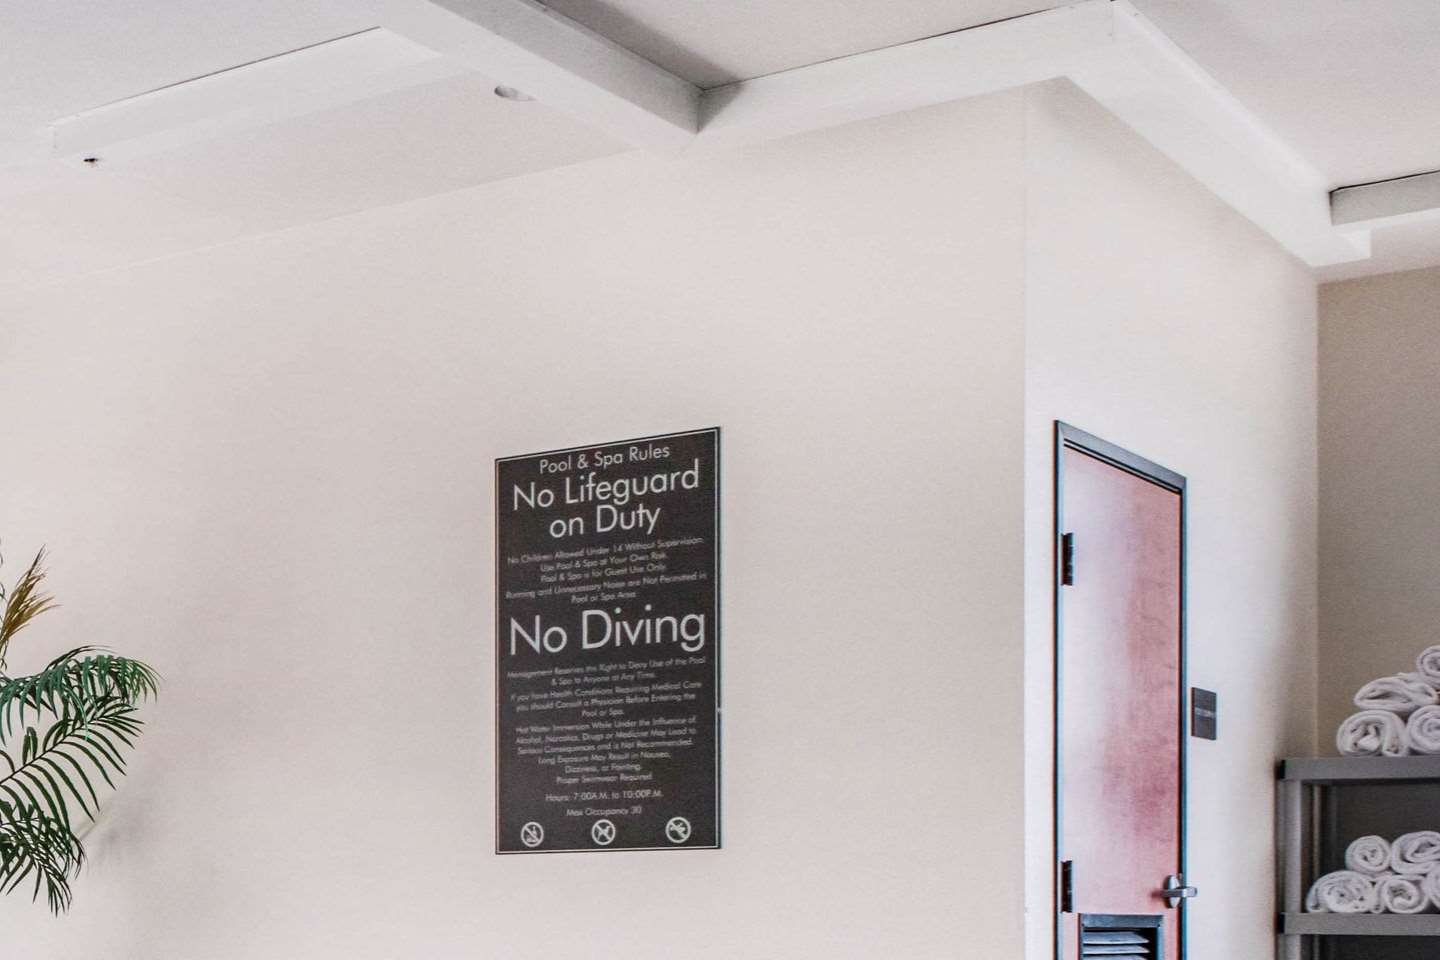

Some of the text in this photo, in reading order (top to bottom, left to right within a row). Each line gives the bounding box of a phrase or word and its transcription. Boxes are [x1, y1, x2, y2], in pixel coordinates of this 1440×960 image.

[540, 444, 670, 474] Pool & Spa Rules
[513, 458, 699, 511] No Lifeguard
[549, 503, 661, 538] on Duty
[586, 547, 610, 556] Under
[625, 542, 656, 551] Without
[541, 563, 555, 572] Use
[556, 560, 573, 570] Pool
[574, 560, 581, 568] &
[583, 559, 598, 568] Spa
[600, 558, 608, 566] at
[609, 556, 628, 564] Your
[629, 553, 649, 562] Own
[541, 573, 557, 582] Pool
[559, 572, 565, 581] &
[567, 571, 582, 581] Spa
[592, 568, 602, 577] for
[604, 567, 628, 576] Guest
[629, 565, 644, 574] Use
[537, 587, 552, 596] and
[627, 580, 641, 588] are
[642, 576, 658, 585] Not
[660, 571, 697, 583] Permitted
[571, 594, 588, 603] Pool
[601, 592, 615, 601] Spa
[510, 604, 705, 656] No Diving
[585, 665, 597, 673] the
[599, 663, 617, 673] Right
[628, 660, 648, 670] Deny
[649, 659, 664, 668] Use
[665, 658, 673, 666] of
[675, 657, 687, 665] the
[688, 656, 706, 665] Pool
[559, 677, 573, 686] Spa
[583, 675, 610, 684] Anyone
[621, 672, 635, 682] Any
[517, 694, 530, 703] you
[531, 692, 548, 700] have
[550, 690, 573, 699] Health
[615, 685, 650, 694] Requiring
[651, 682, 681, 691] Medical
[683, 680, 702, 689] Care
[555, 699, 582, 709] Consult
[591, 698, 624, 708] Physician
[625, 695, 650, 704] Before
[651, 693, 682, 703] Entering
[683, 692, 696, 700] the
[582, 708, 597, 717] Pool
[599, 709, 607, 717] or
[515, 726, 528, 734] Hot
[529, 724, 551, 733] Water
[591, 720, 612, 729] While
[614, 719, 636, 728] Under
[639, 718, 650, 727] the
[652, 716, 687, 726] Influence
[687, 714, 697, 724] of
[582, 732, 604, 742] Drugs
[605, 732, 614, 740] or
[650, 728, 667, 738] May
[668, 726, 687, 736] Lead
[688, 727, 697, 735] to
[544, 744, 596, 755] Consequences
[597, 742, 611, 751] and
[620, 741, 635, 750] Not
[538, 756, 556, 766] Long
[557, 754, 589, 764] Exposure
[590, 753, 607, 763] May
[608, 751, 630, 761] Result
[601, 765, 610, 773] or
[611, 791, 620, 800] to
[566, 805, 642, 818] Max Occupancy 30
